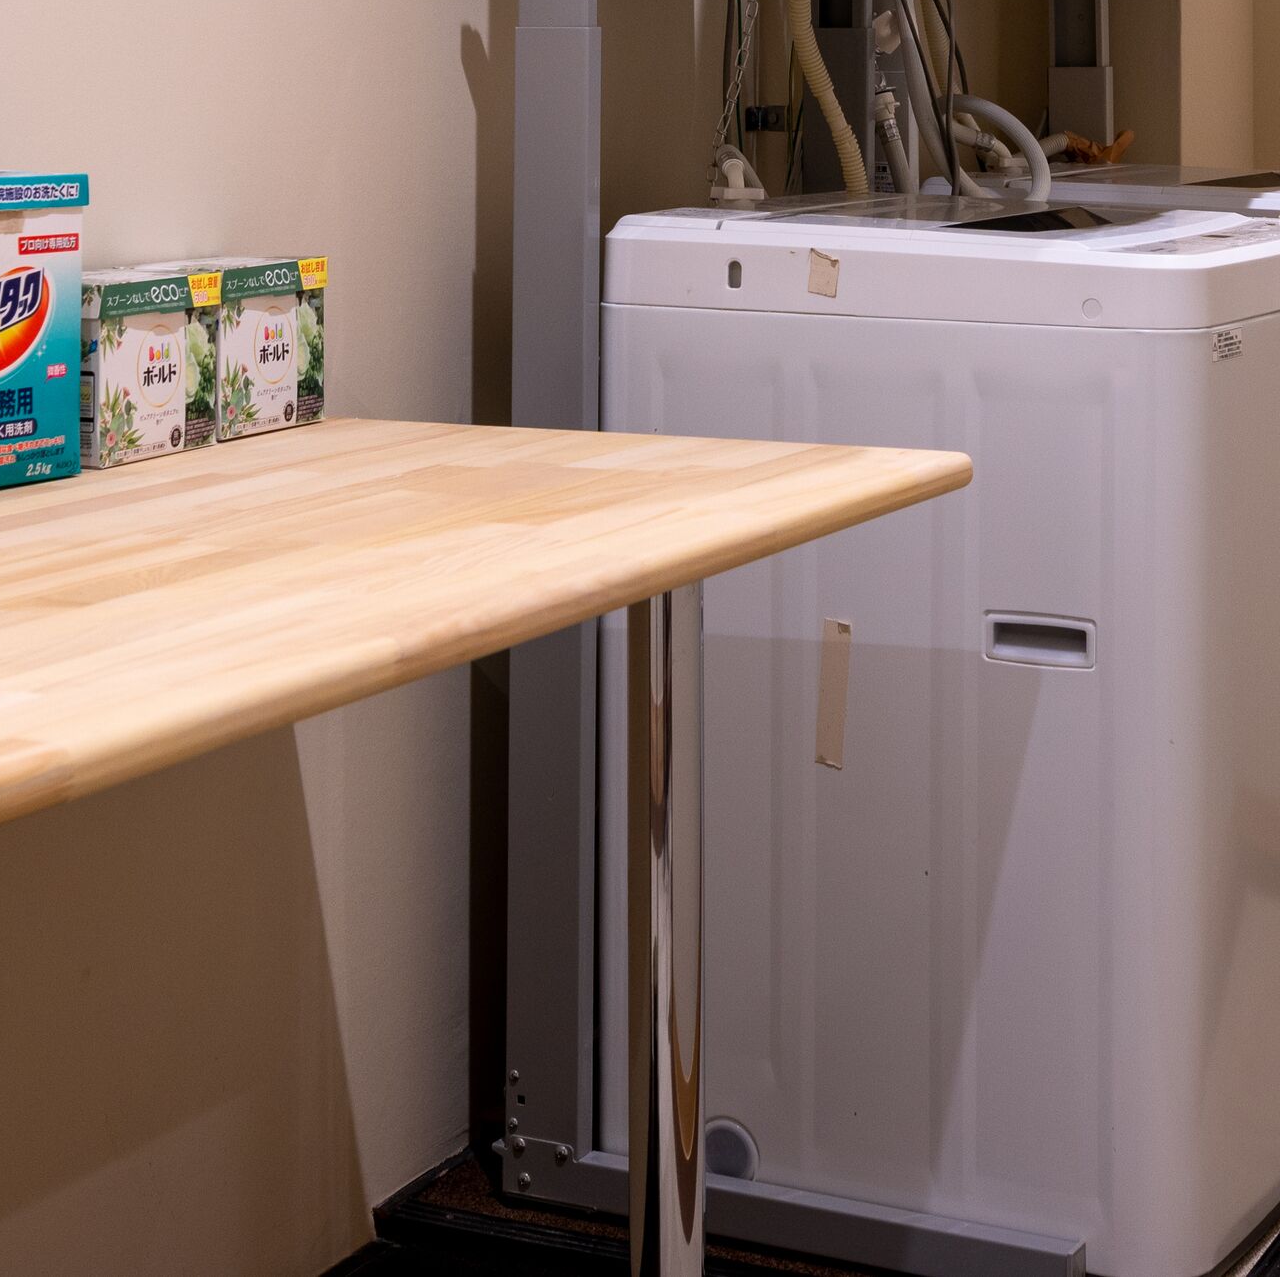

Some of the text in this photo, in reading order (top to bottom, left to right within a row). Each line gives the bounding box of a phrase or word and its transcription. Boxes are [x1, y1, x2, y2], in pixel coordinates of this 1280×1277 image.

[21, 236, 77, 251] プロ向け専用処方
[300, 260, 325, 274] お試し容量
[191, 275, 219, 290] お試し容量
[258, 342, 290, 365] ボールド
[142, 363, 177, 387] ボールド
[26, 463, 52, 476] 2.5kg
